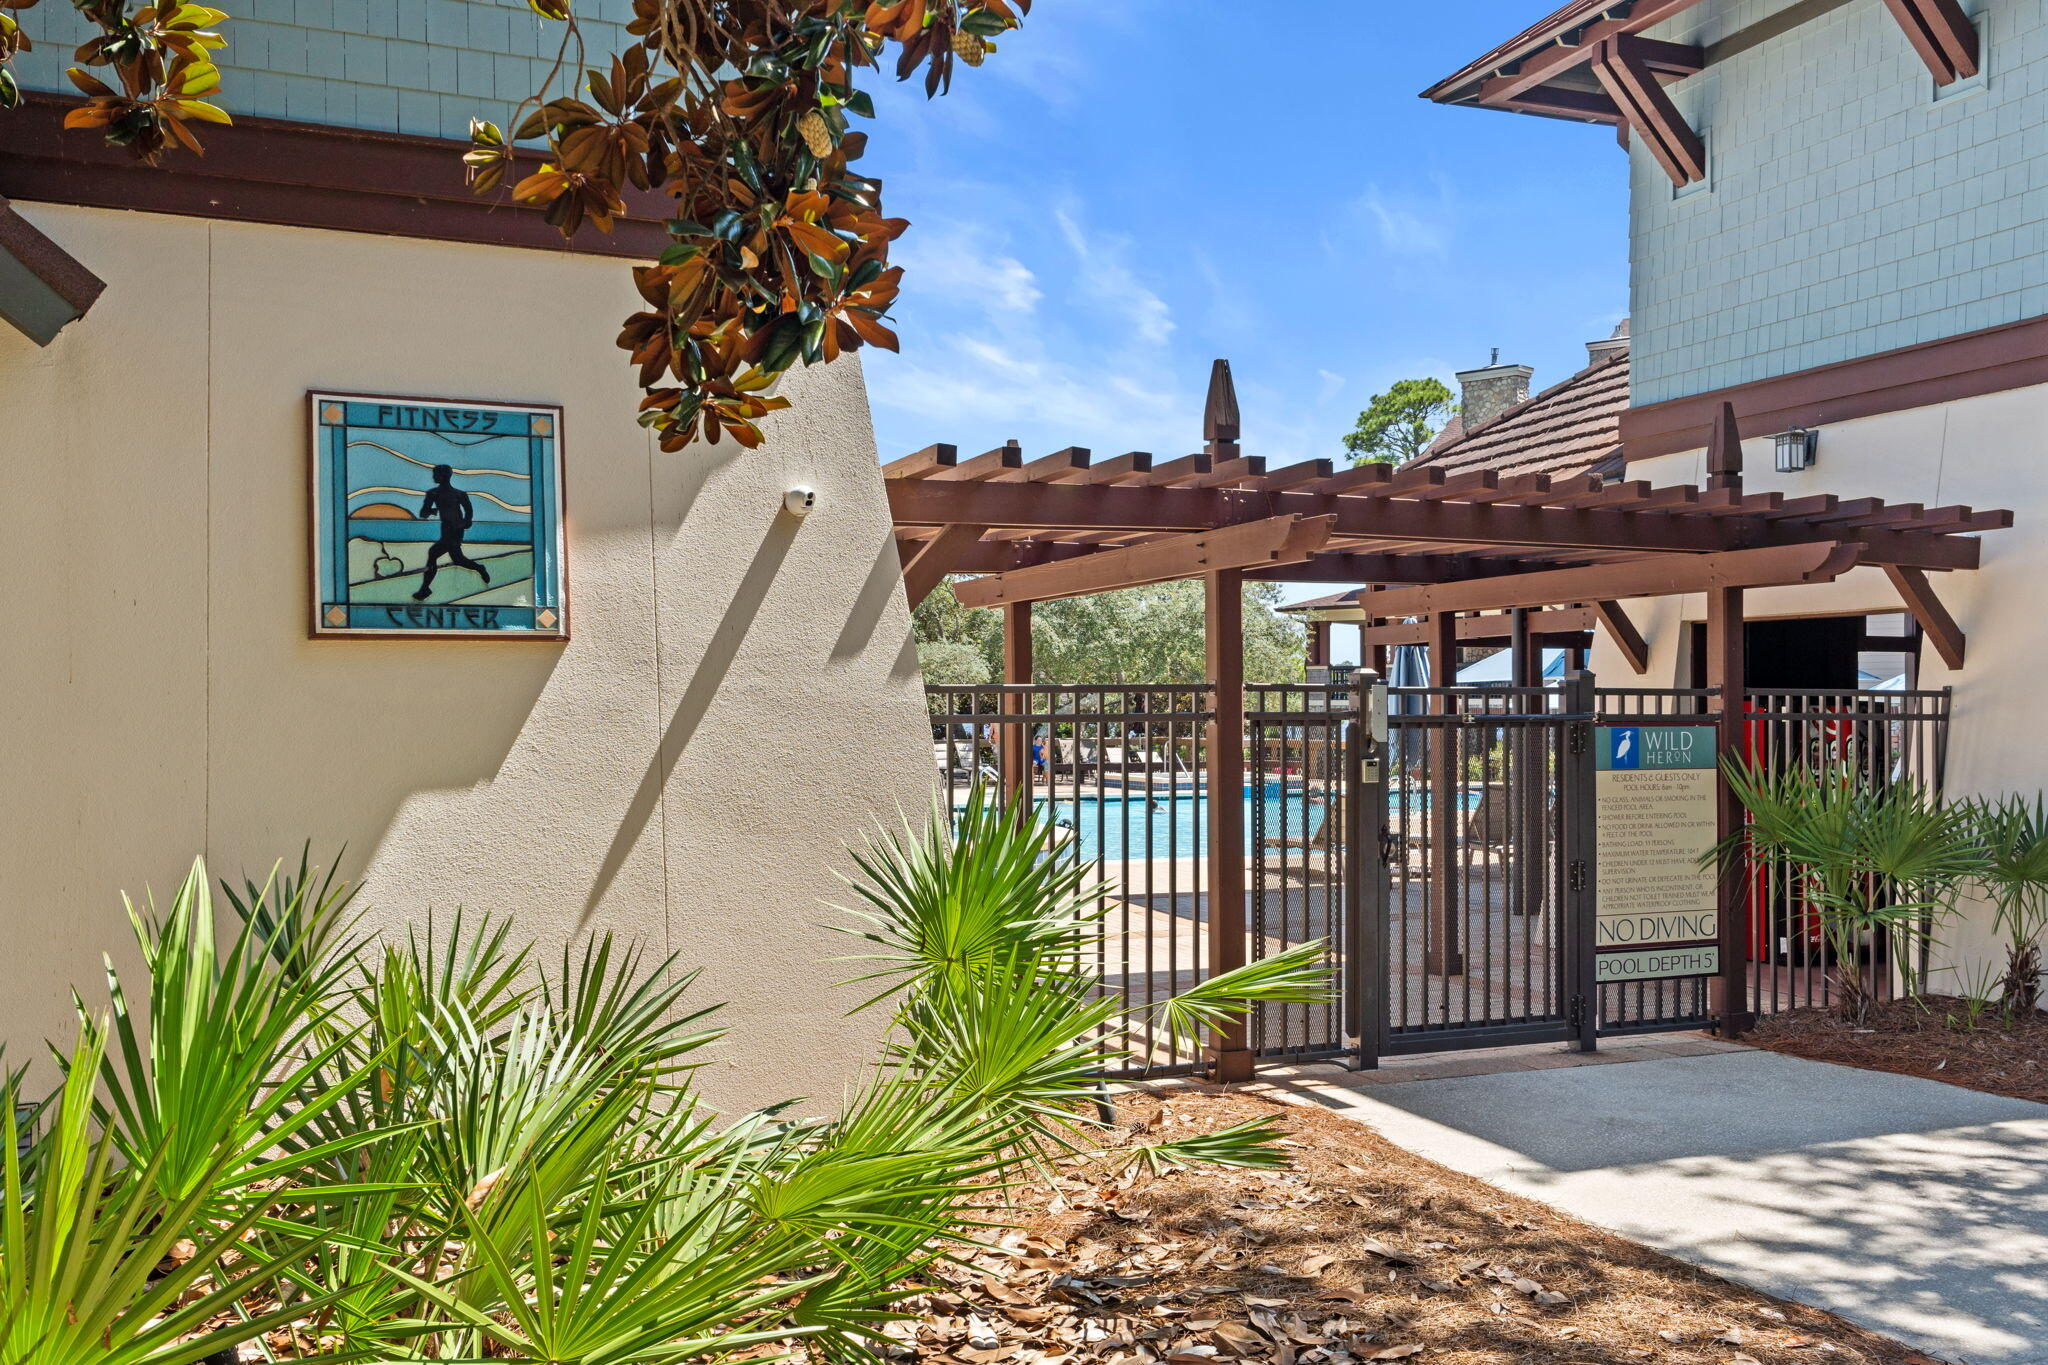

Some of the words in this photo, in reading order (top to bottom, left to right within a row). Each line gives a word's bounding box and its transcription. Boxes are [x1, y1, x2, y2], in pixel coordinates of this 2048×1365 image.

[378, 405, 499, 430] FITNESS
[385, 606, 500, 629] CENTER
[1645, 731, 1693, 751] WILD
[1646, 751, 1692, 765] HERON
[1612, 773, 1647, 783] RESIDENTS
[1655, 772, 1681, 782] GUESTS
[1681, 772, 1701, 781] ONLY
[1676, 783, 1690, 793] 10pm
[1630, 795, 1655, 803] ANIMALS
[1664, 794, 1689, 802] SMOKING
[1601, 803, 1623, 811] FENCED
[1623, 803, 1638, 811] POOL
[1637, 822, 1654, 830] DRINK
[1655, 821, 1680, 829] ALLOWED
[1695, 820, 1716, 828] WITHIN
[1651, 839, 1675, 847] PERSONS
[1602, 850, 1630, 858] MAXIMUM
[1630, 849, 1649, 857] WATER
[1602, 860, 1629, 868] CHILDREN
[1629, 859, 1648, 867] UNDER
[1655, 858, 1671, 866] MUST
[1602, 868, 1636, 876] SUPERVISION
[1612, 877, 1624, 885] NOT
[1625, 876, 1647, 884] URINATE
[1636, 885, 1650, 893] WHO
[1636, 900, 1671, 908] WATERPROOF
[1599, 918, 1635, 943] NO
[1640, 914, 1716, 940] DIVING
[1599, 957, 1645, 976] POOL
[1649, 954, 1701, 973] DEPTH
